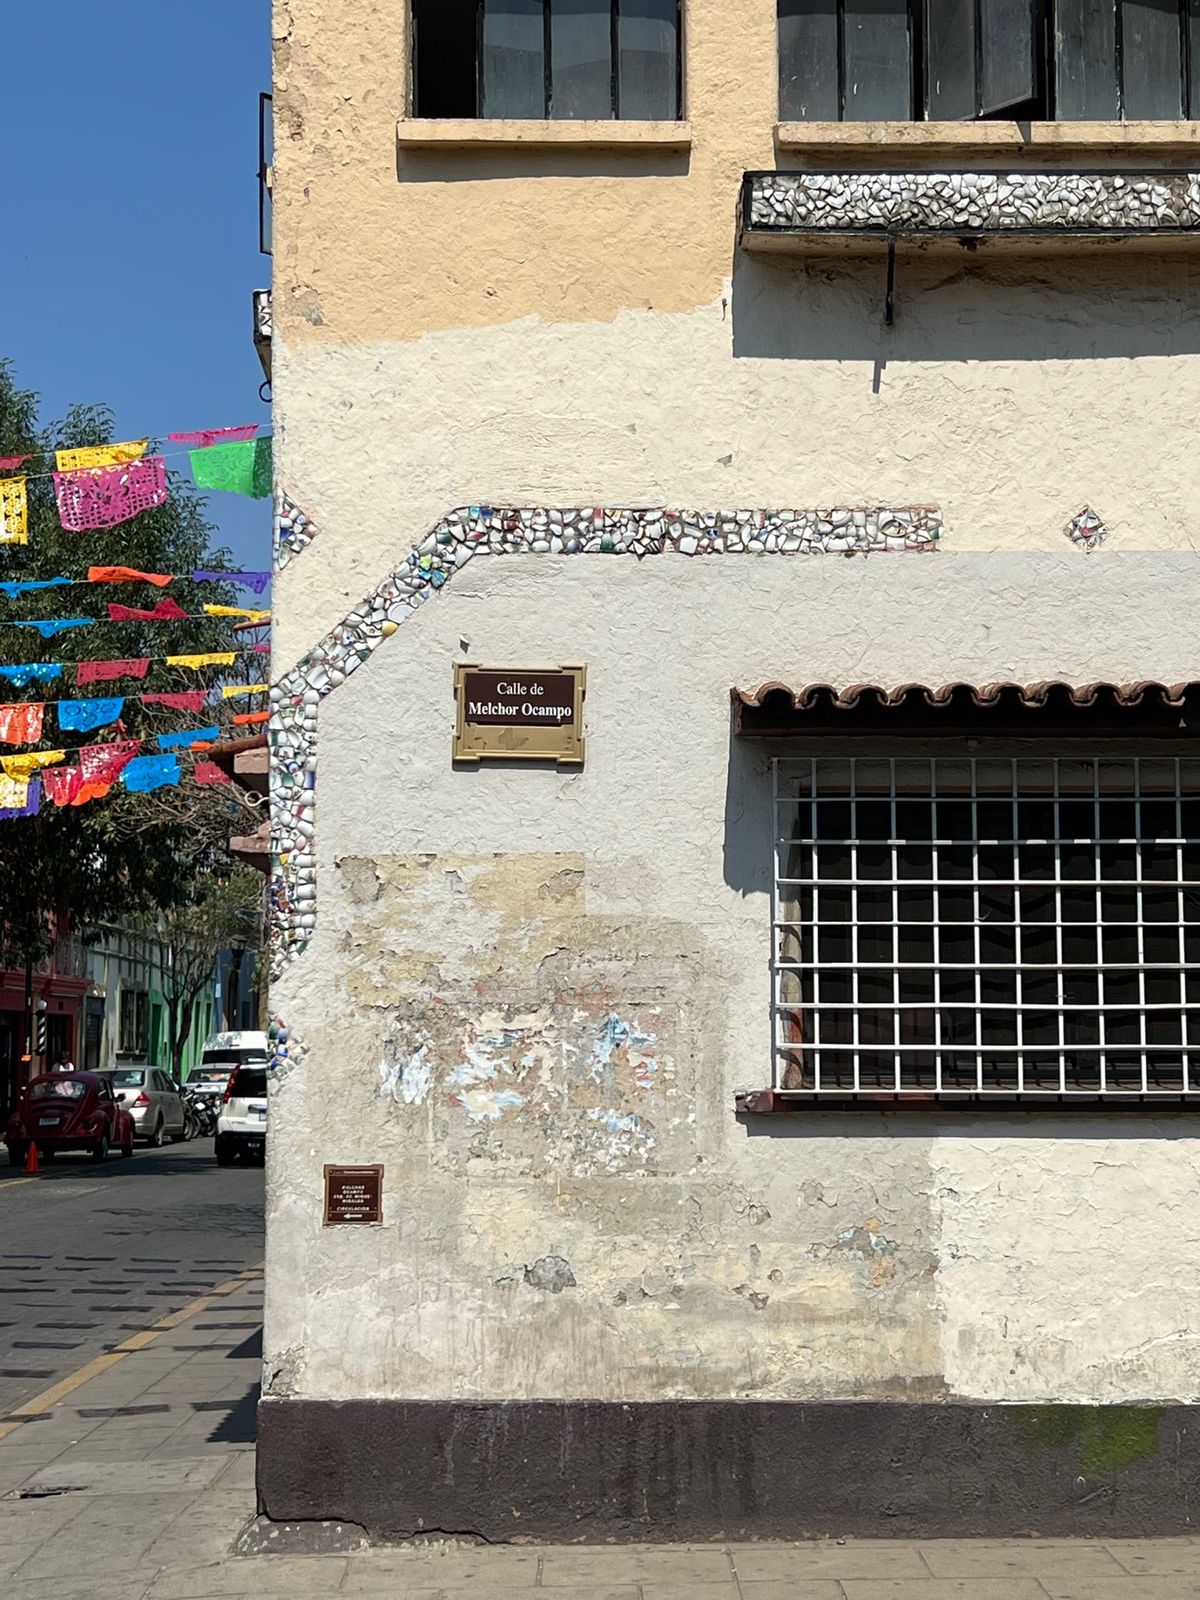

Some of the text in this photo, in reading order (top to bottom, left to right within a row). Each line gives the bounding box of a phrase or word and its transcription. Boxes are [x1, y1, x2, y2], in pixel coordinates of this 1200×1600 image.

[497, 682, 545, 695] Calle de
[468, 702, 572, 722] Melchor Ocampo
